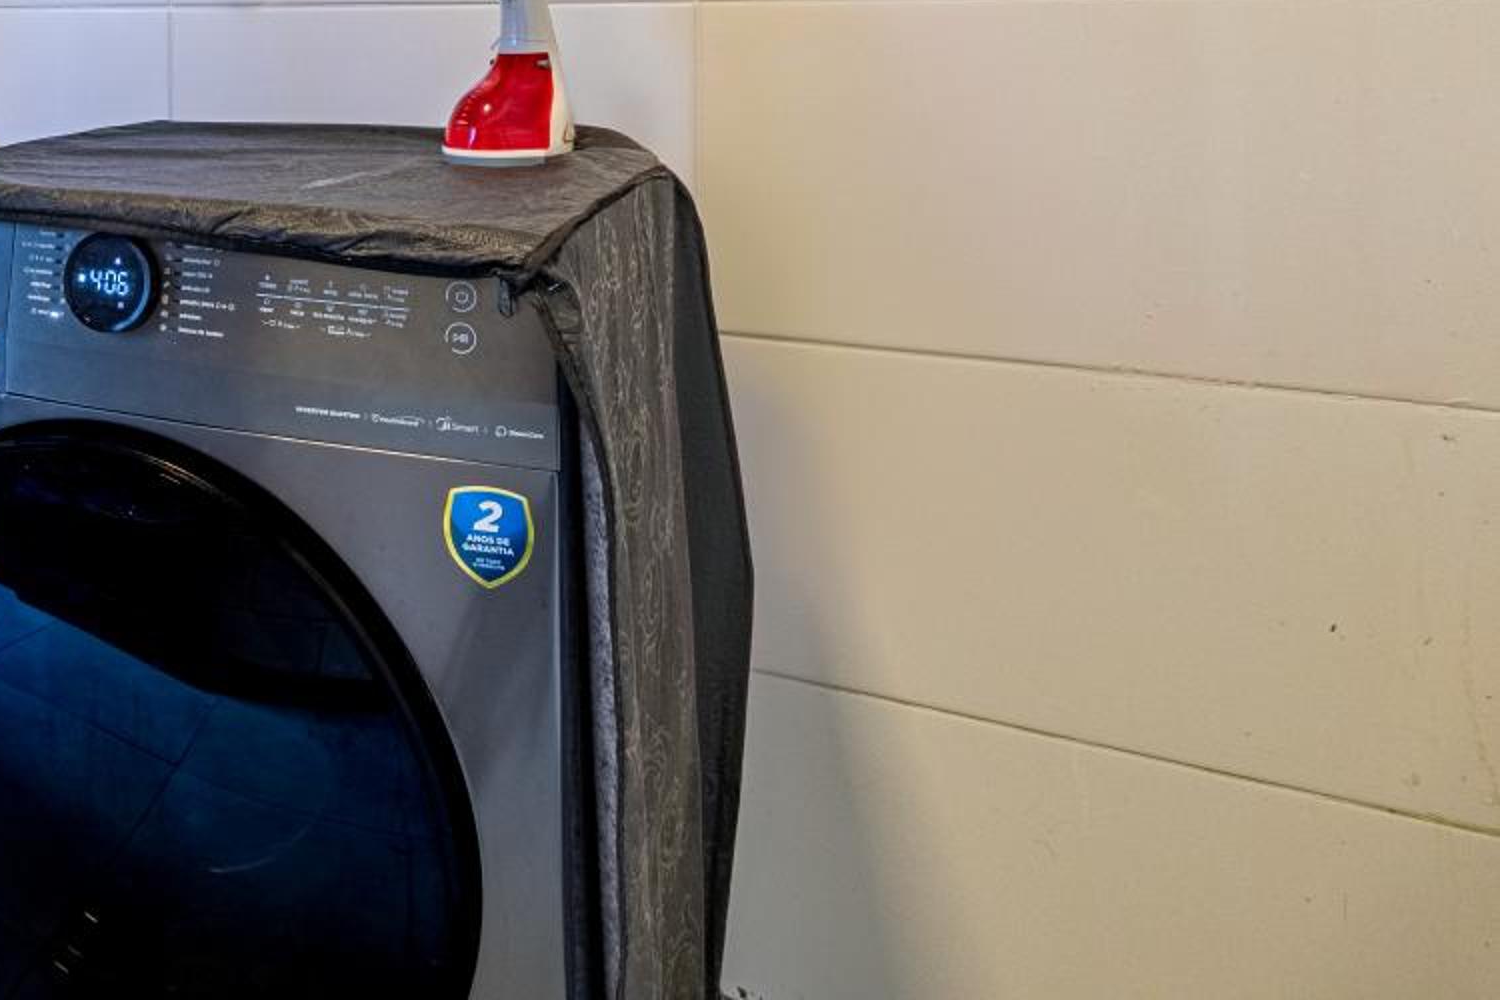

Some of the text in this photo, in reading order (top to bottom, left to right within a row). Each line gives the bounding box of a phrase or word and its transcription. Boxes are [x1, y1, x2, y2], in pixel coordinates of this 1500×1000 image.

[473, 500, 503, 533] 2
[466, 534, 495, 545] ANOS
[461, 542, 514, 556] GARANTIA
